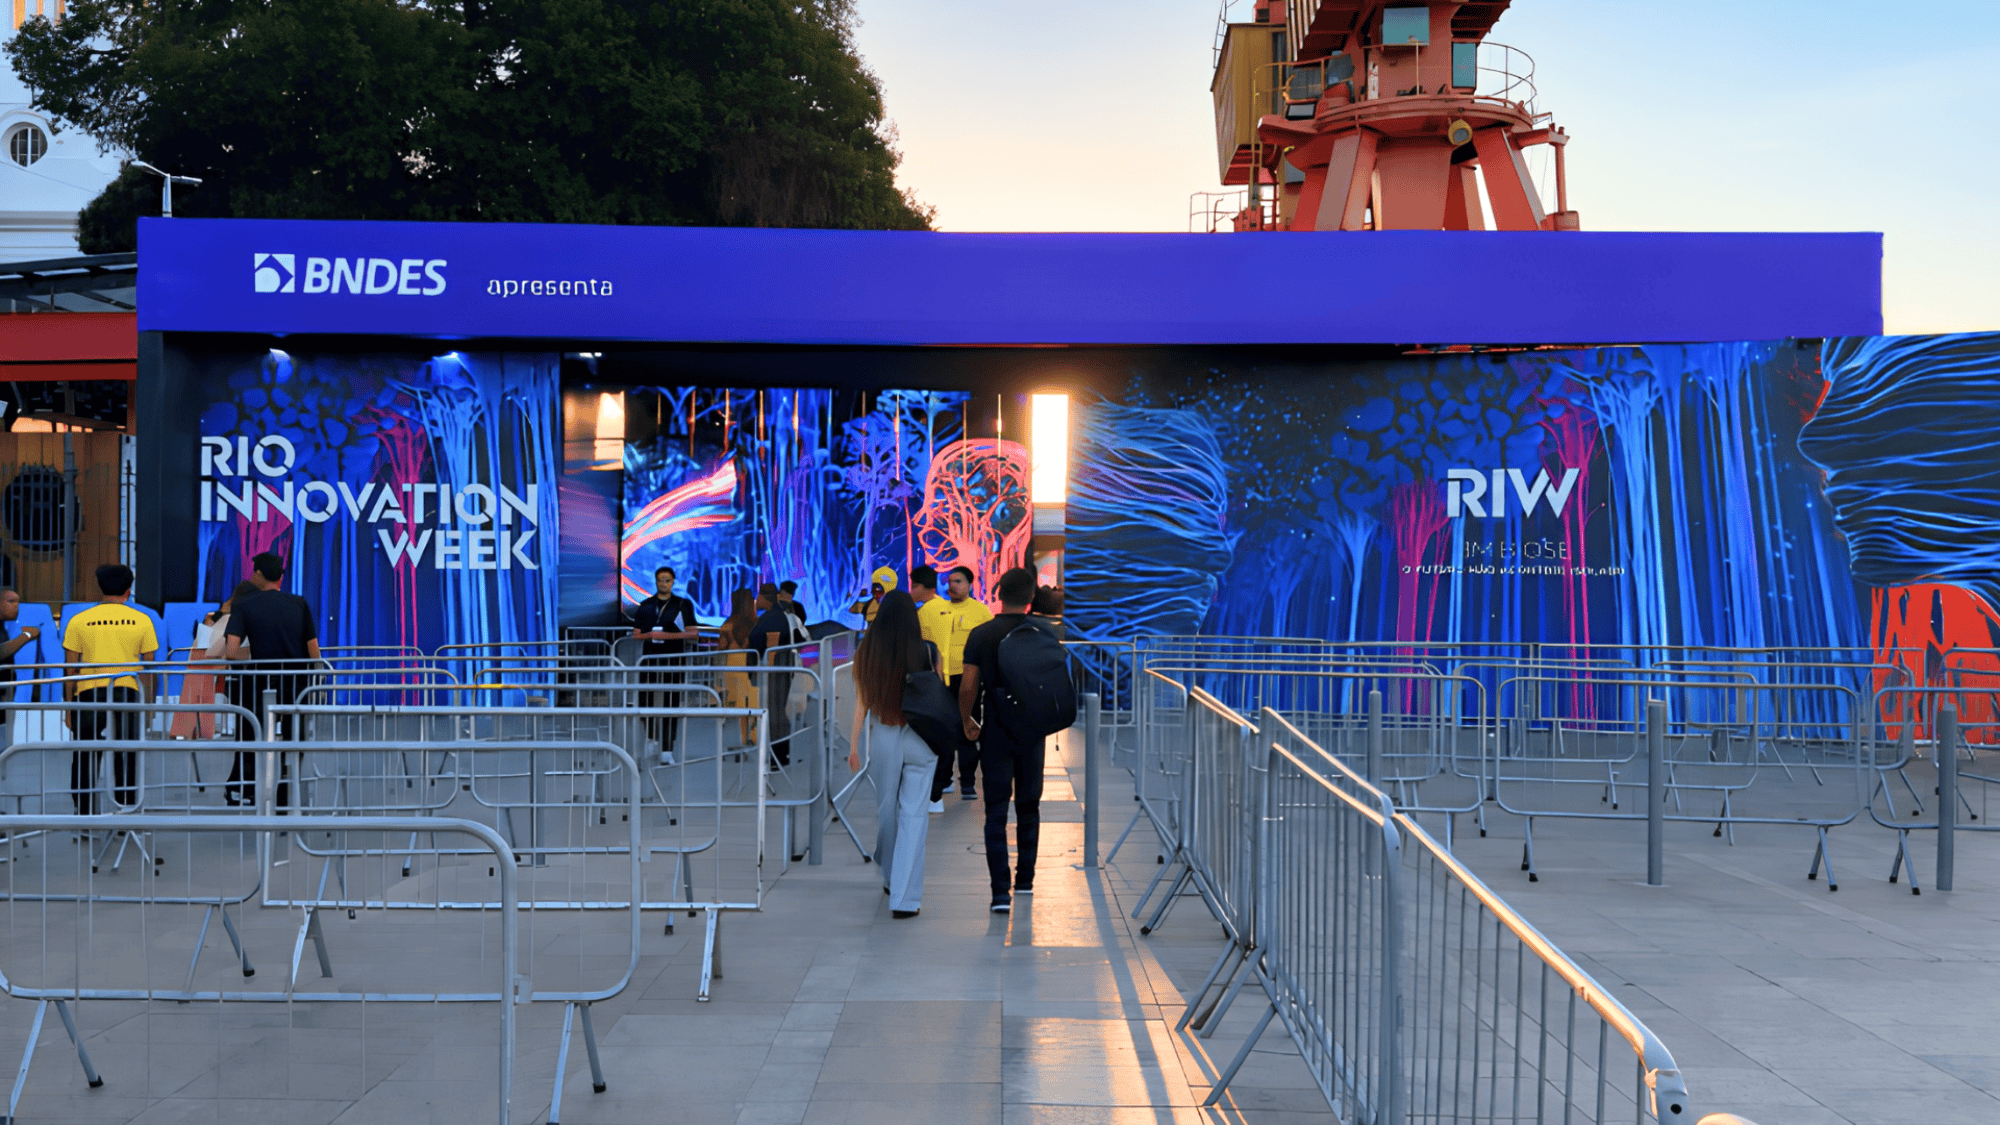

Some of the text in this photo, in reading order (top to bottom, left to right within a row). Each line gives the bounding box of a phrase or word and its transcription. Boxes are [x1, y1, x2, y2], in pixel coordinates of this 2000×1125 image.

[303, 257, 613, 298] BNDES apresenta
[200, 434, 296, 477] RIO
[200, 480, 538, 526] INNOVATION
[1447, 468, 1580, 519] RIW
[377, 528, 539, 570] WEEK
